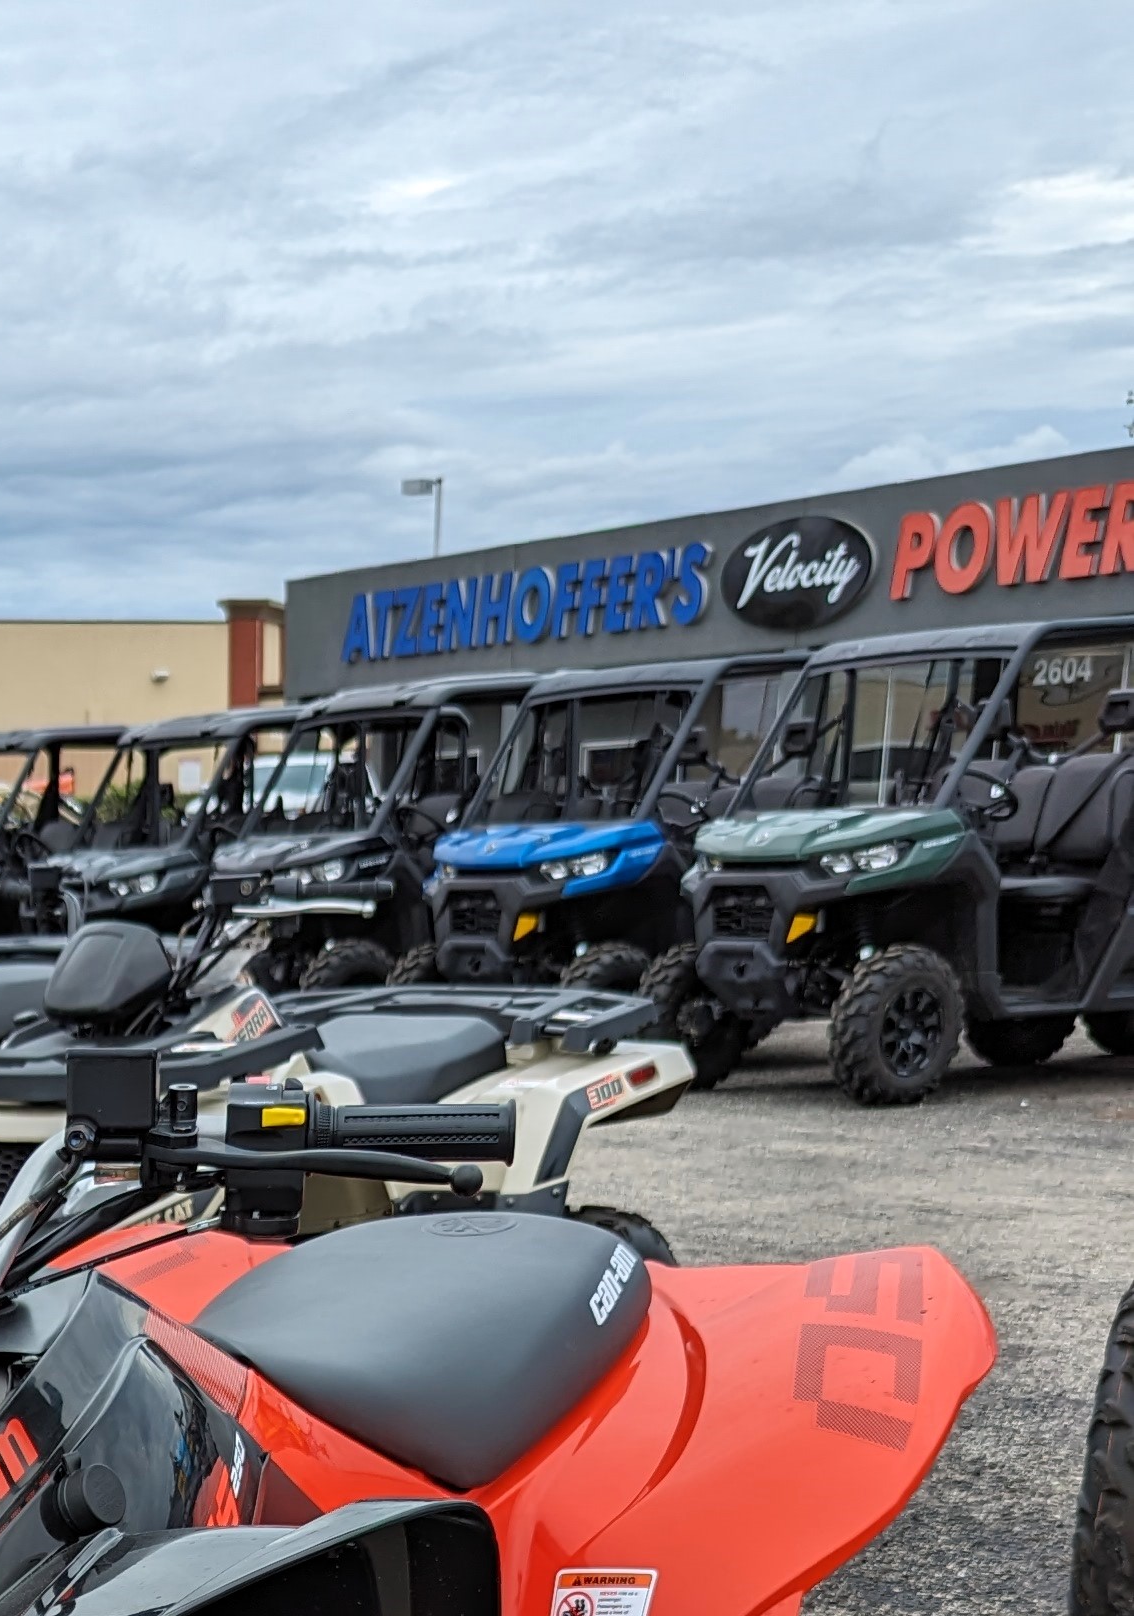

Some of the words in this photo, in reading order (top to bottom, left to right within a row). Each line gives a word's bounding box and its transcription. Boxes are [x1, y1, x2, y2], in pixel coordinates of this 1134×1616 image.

[737, 532, 861, 609] Velocity
[341, 541, 714, 662] ATZENHOFFER'S
[1032, 655, 1092, 687] 2604
[588, 1079, 623, 1103] 300
[589, 1242, 638, 1326] can-am
[583, 1576, 636, 1585] WARNING
